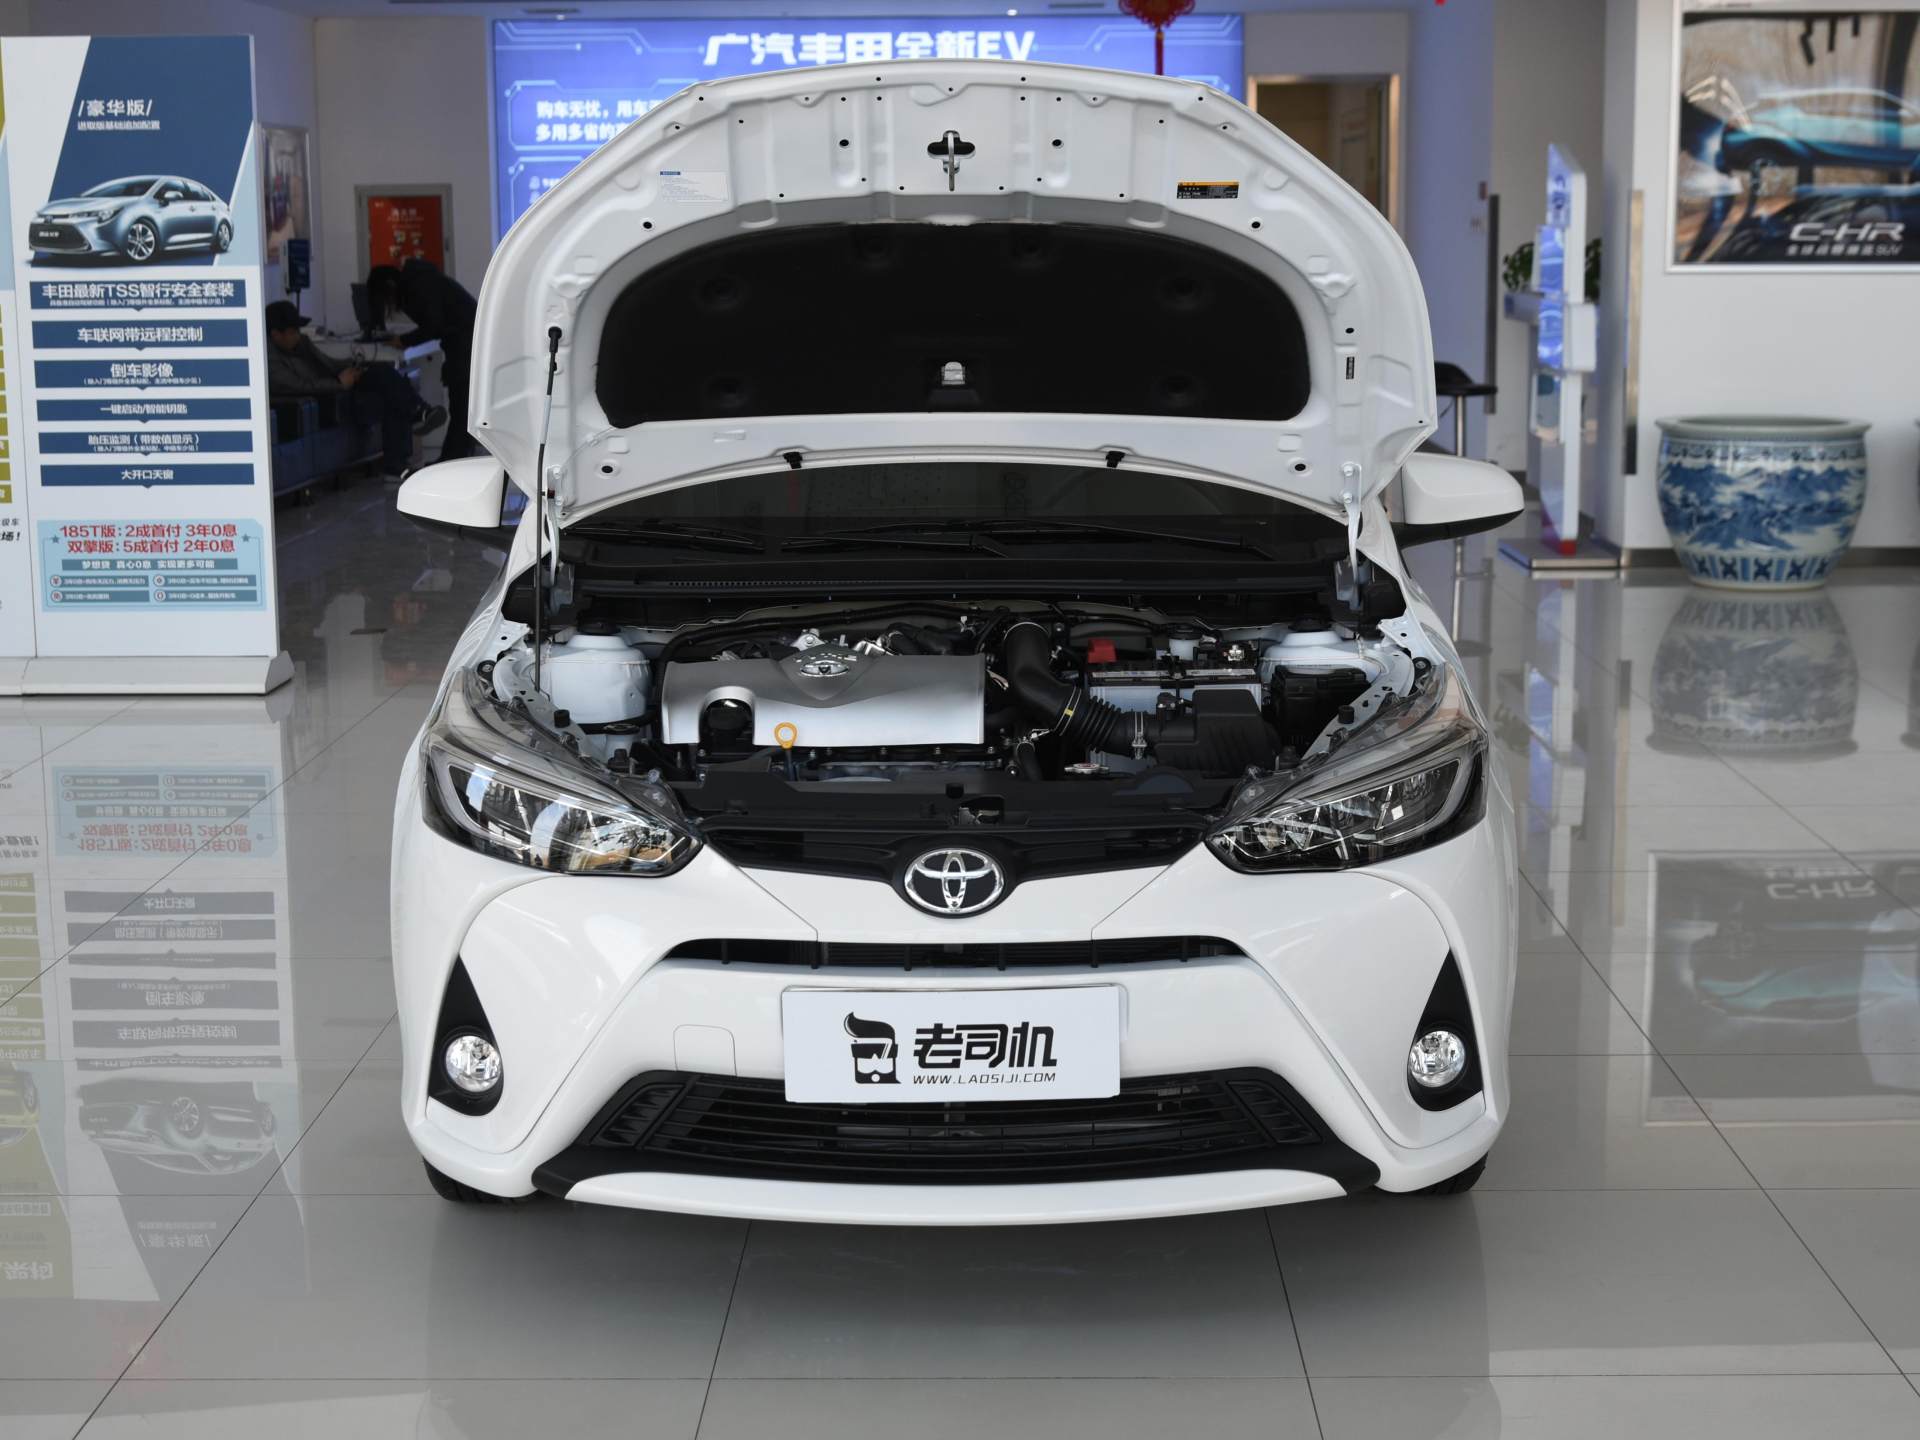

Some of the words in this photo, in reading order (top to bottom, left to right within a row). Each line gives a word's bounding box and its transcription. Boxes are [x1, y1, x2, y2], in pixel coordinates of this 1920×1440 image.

[703, 31, 1035, 66] 广汽丰田全新EV
[1789, 222, 1905, 241] C-HR
[42, 283, 235, 299] 丰田最新TSS智行安全套装
[77, 326, 203, 343] 车联网带远程控制
[110, 363, 174, 378] 倒车影像
[100, 403, 188, 415] 一键启动/智能钥匙
[121, 469, 174, 480] 大开口天窗
[185, 523, 237, 538] 3年0息
[183, 539, 235, 553] 2年0息
[913, 1021, 1057, 1069] 老司机
[913, 1072, 1057, 1085] WWW.LAOSIJI.COM
